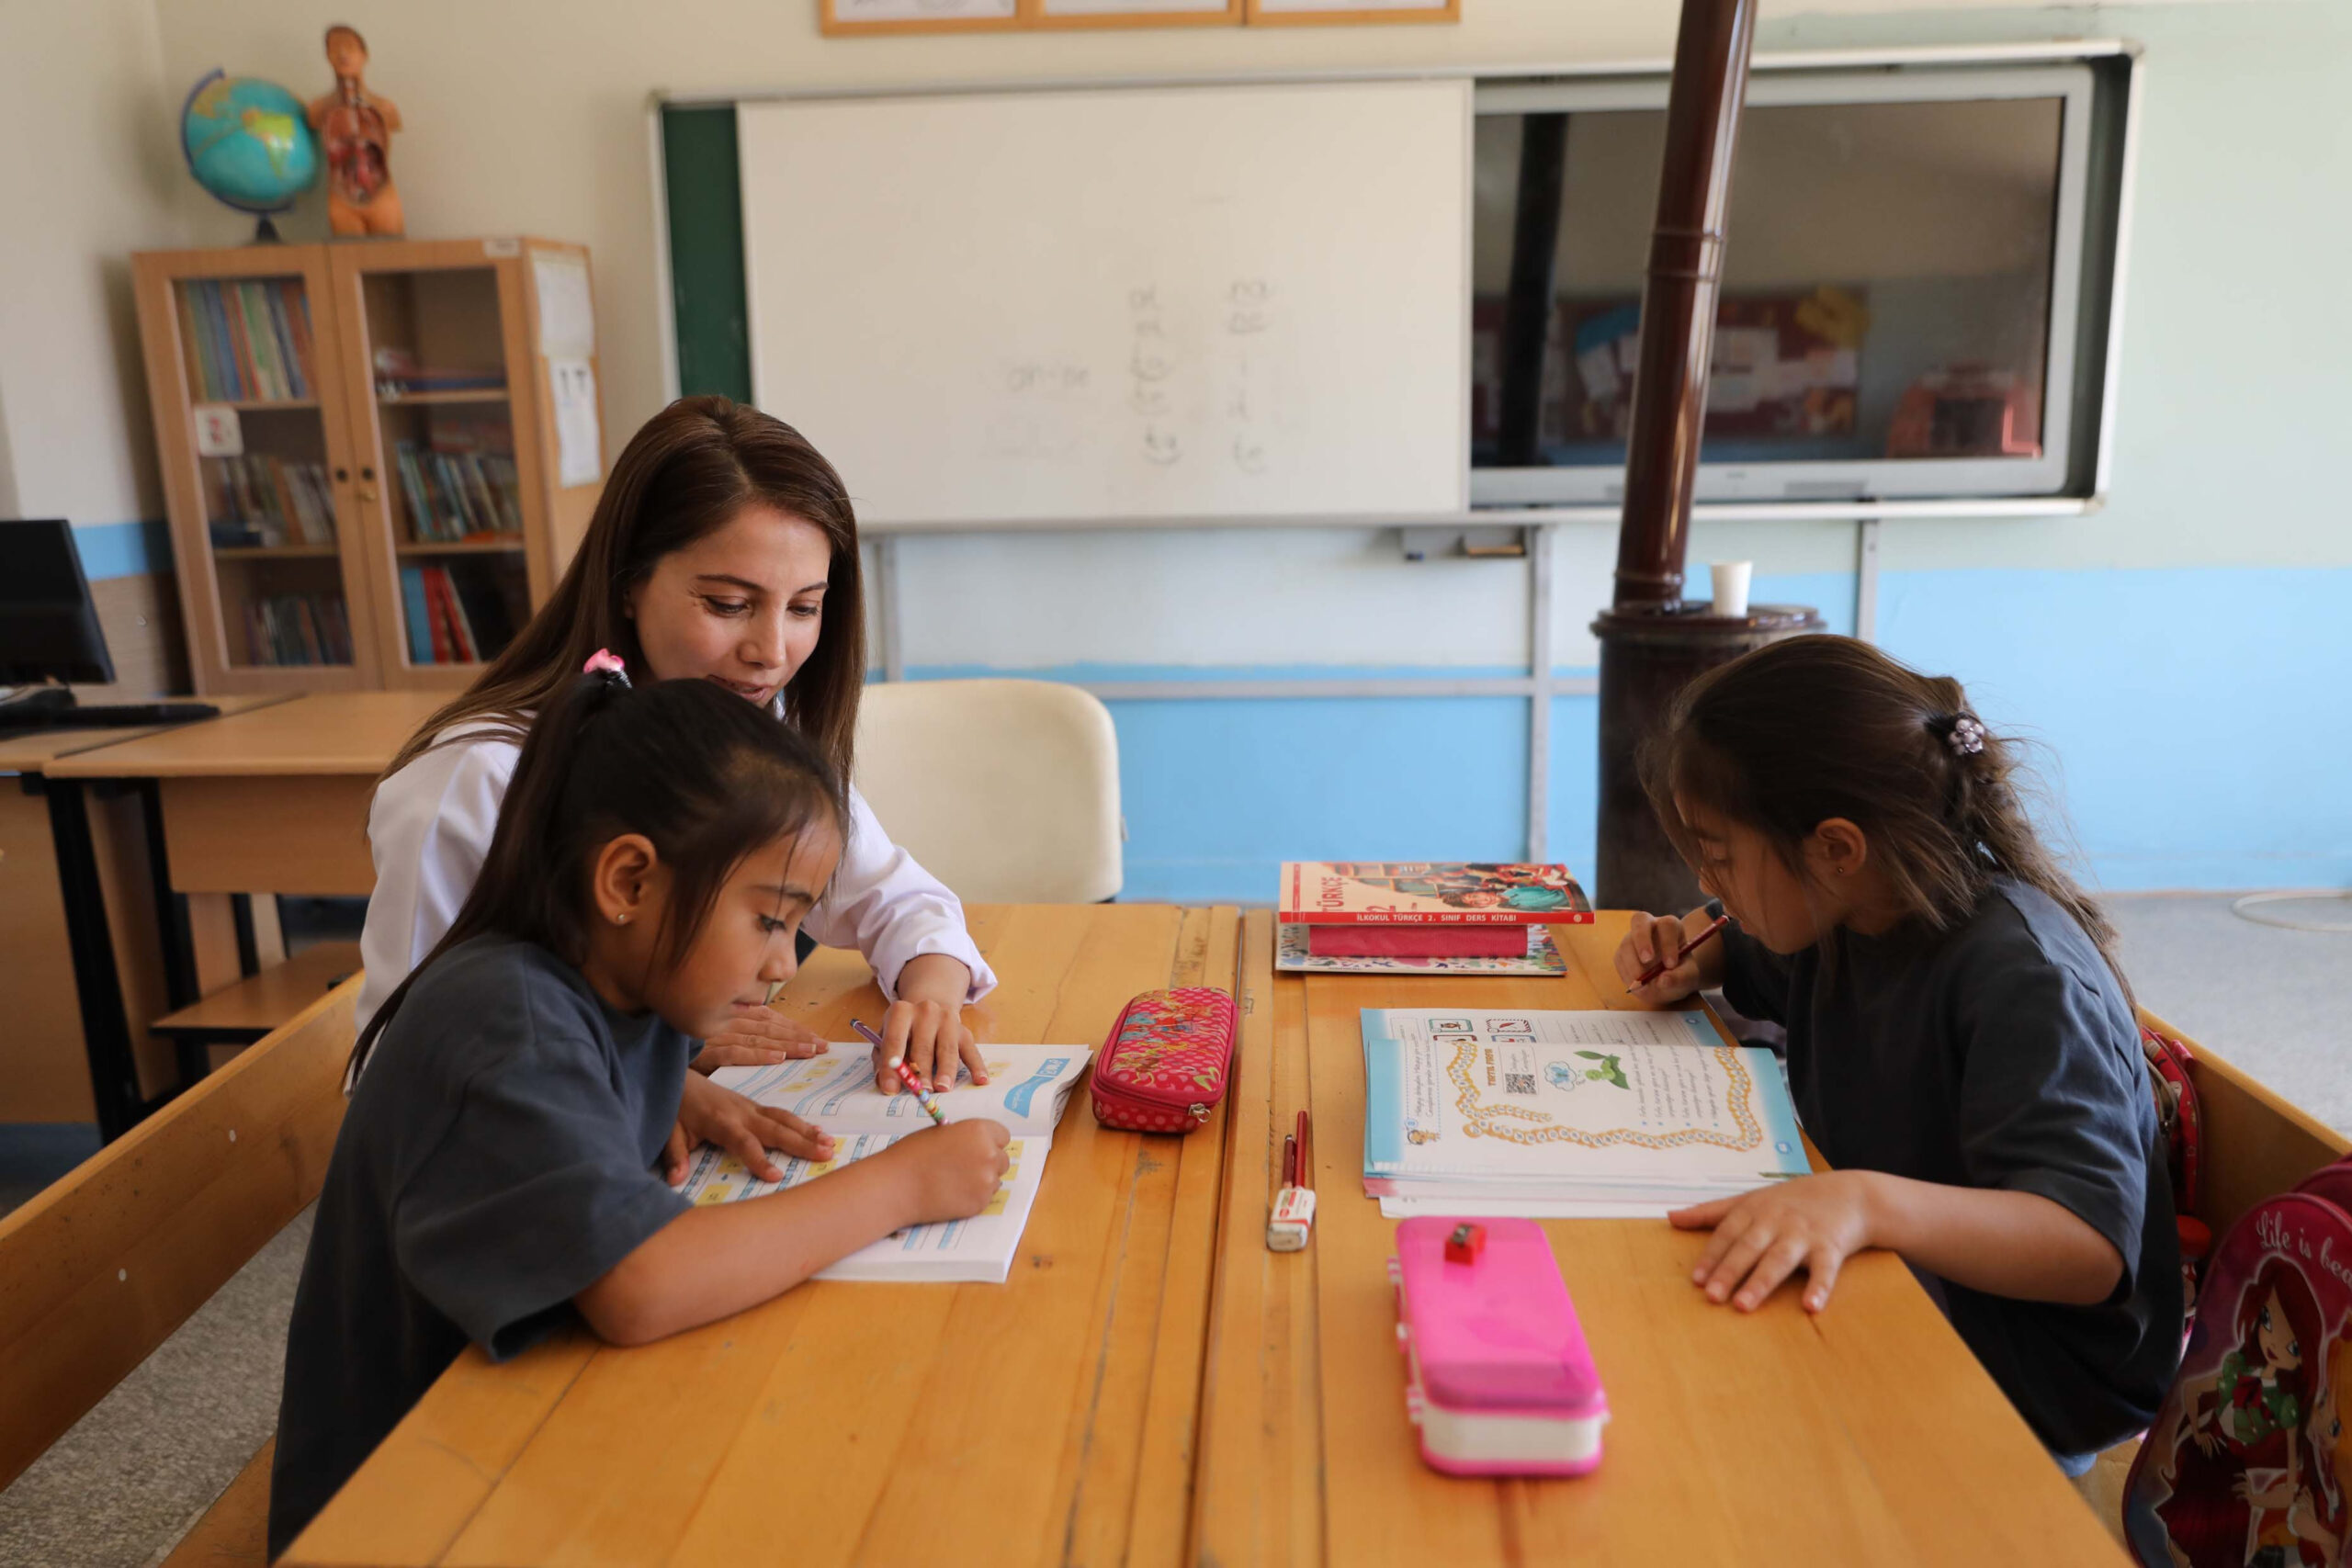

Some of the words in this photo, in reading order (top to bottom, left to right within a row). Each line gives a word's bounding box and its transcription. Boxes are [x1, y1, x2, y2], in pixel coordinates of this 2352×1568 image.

[1316, 876, 1348, 912] TÜRKÇE
[1356, 913, 1390, 921] İLKOKUL
[1393, 913, 1423, 922] TÜRKÇE
[1491, 913, 1517, 921] KİTABI
[2256, 1210, 2290, 1253] Life
[2299, 1227, 2312, 1259] is
